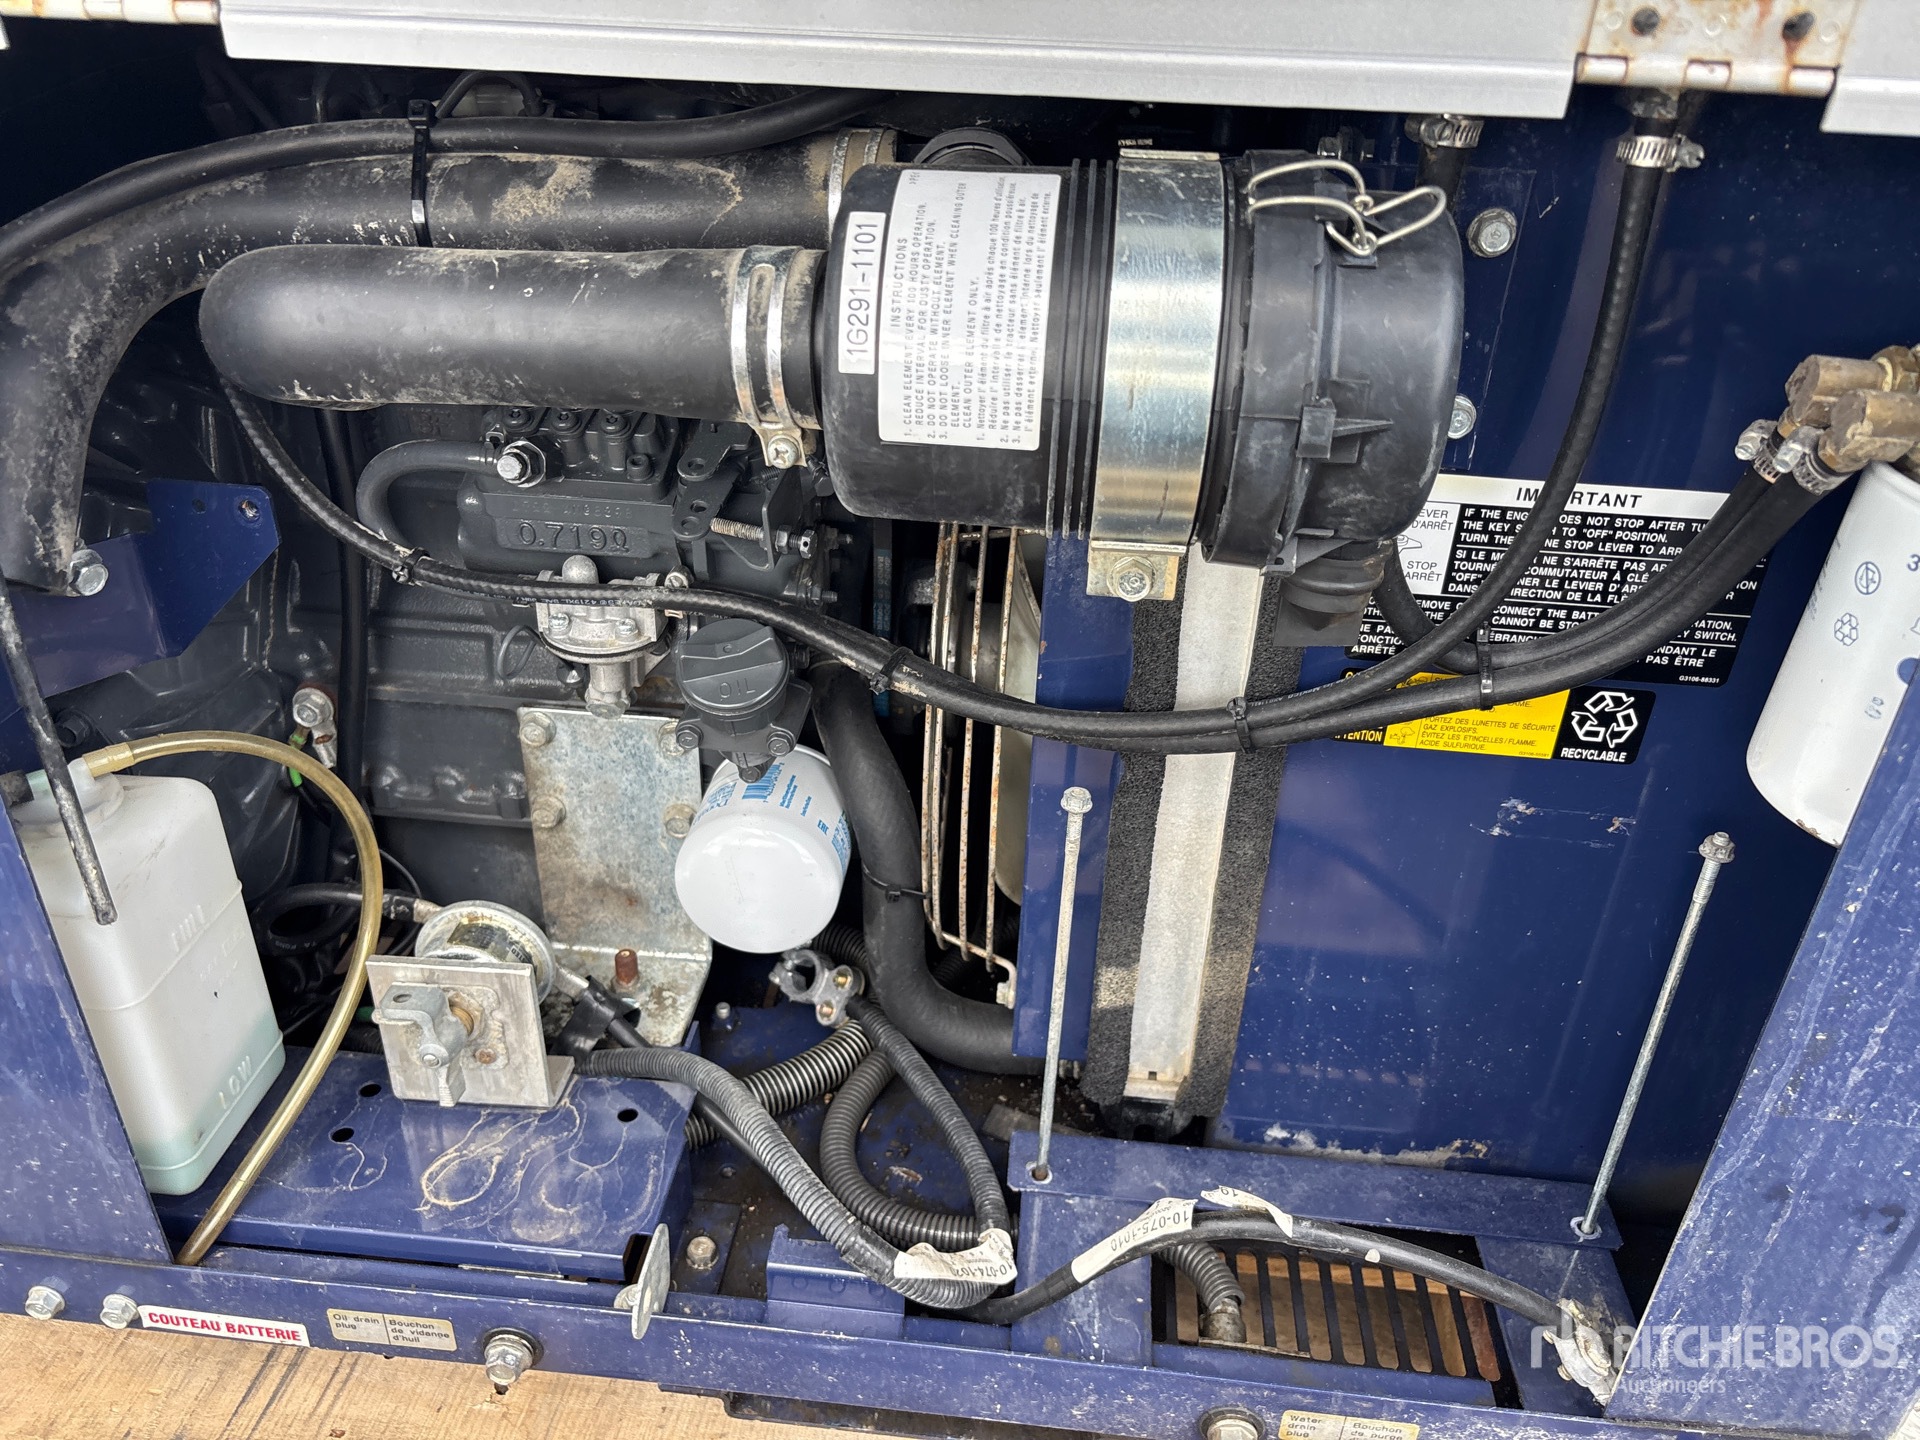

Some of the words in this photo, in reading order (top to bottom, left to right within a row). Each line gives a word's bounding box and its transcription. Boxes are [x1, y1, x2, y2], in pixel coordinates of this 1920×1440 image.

[912, 203, 927, 247] OPERATION.
[923, 219, 936, 270] OPERATION.
[909, 252, 919, 282] HOURS
[933, 242, 945, 285] ELEMENT.
[846, 224, 877, 355] 1G291-1101
[890, 238, 907, 327] INSTRUCTIONS
[919, 275, 929, 306] DUSTY
[944, 271, 954, 314] ELEMENT
[968, 277, 979, 306] ONLY.
[917, 311, 927, 330] FOR
[930, 291, 941, 335] WITHOUT
[905, 309, 914, 340] EVERY
[966, 311, 976, 356] ELEMENT
[904, 345, 912, 390] ELEMENT
[928, 341, 937, 386] OPERATE
[964, 362, 973, 394] OUTER
[904, 395, 912, 424] CLEAN
[915, 389, 924, 425] REDUCE
[928, 391, 936, 409] NOT
[940, 392, 948, 410] NOT
[951, 381, 961, 427] ELEMENT.
[928, 415, 935, 426] DO
[940, 415, 947, 426] DO
[963, 399, 971, 428] CLEAN
[1516, 487, 1642, 508] IMRTANT
[1418, 509, 1448, 518] EVER
[1465, 509, 1475, 517] IF
[1480, 509, 1501, 518] THE
[1559, 515, 1581, 524] OES
[1587, 516, 1610, 526] NOT
[1615, 518, 1644, 528] STOP
[1649, 521, 1685, 531] AFTER
[1463, 521, 1483, 530] THE
[1488, 523, 1510, 532] KEY
[1562, 527, 1577, 536] TO
[1583, 529, 1613, 539] "OFF"
[1615, 531, 1668, 543] POSITION.
[1460, 533, 1488, 543] TURN
[1494, 535, 1514, 544] THE
[1565, 540, 1593, 550] STOP
[1598, 543, 1633, 553] LEVER
[1640, 545, 1654, 554] TO
[1407, 561, 1437, 569] STOP
[1456, 550, 1467, 558] SI
[1472, 551, 1485, 560] LE
[1543, 557, 1558, 565] NE
[1563, 557, 1618, 569] S'ARRÊTE
[1623, 561, 1646, 571] PAS
[1545, 579, 1559, 588] LE
[1564, 580, 1603, 591] LEVIER
[1627, 573, 1649, 583] CLÉ
[1448, 584, 1478, 593] DANS
[1511, 588, 1562, 599] IRECTION
[1567, 590, 1582, 600] DE
[1587, 592, 1601, 602] LA
[1416, 599, 1451, 610] EMOVE
[1547, 609, 1567, 618] THE
[1492, 616, 1535, 627] CANNOT
[1539, 619, 1554, 628] BE
[1694, 631, 1737, 641] SWITCH.
[1351, 644, 1396, 655] ARRÊTÉ
[1701, 648, 1717, 657] LE
[1646, 656, 1669, 665] PAS
[1674, 655, 1704, 667] ÊTRE
[720, 678, 756, 698] OIL
[1472, 720, 1506, 728] LUNETTES
[1522, 722, 1556, 732] SÉCURITÉ
[1561, 748, 1627, 762] RECYCLABLE
[148, 1312, 221, 1333] COUTEAU
[226, 1322, 301, 1342] BATTERIE
[333, 1313, 349, 1322] Oil
[353, 1315, 380, 1326] drain
[335, 1321, 357, 1332] plug
[389, 1319, 435, 1331] Bouchon
[1290, 1415, 1322, 1424] Water
[1352, 1422, 1402, 1434] Bouchon
